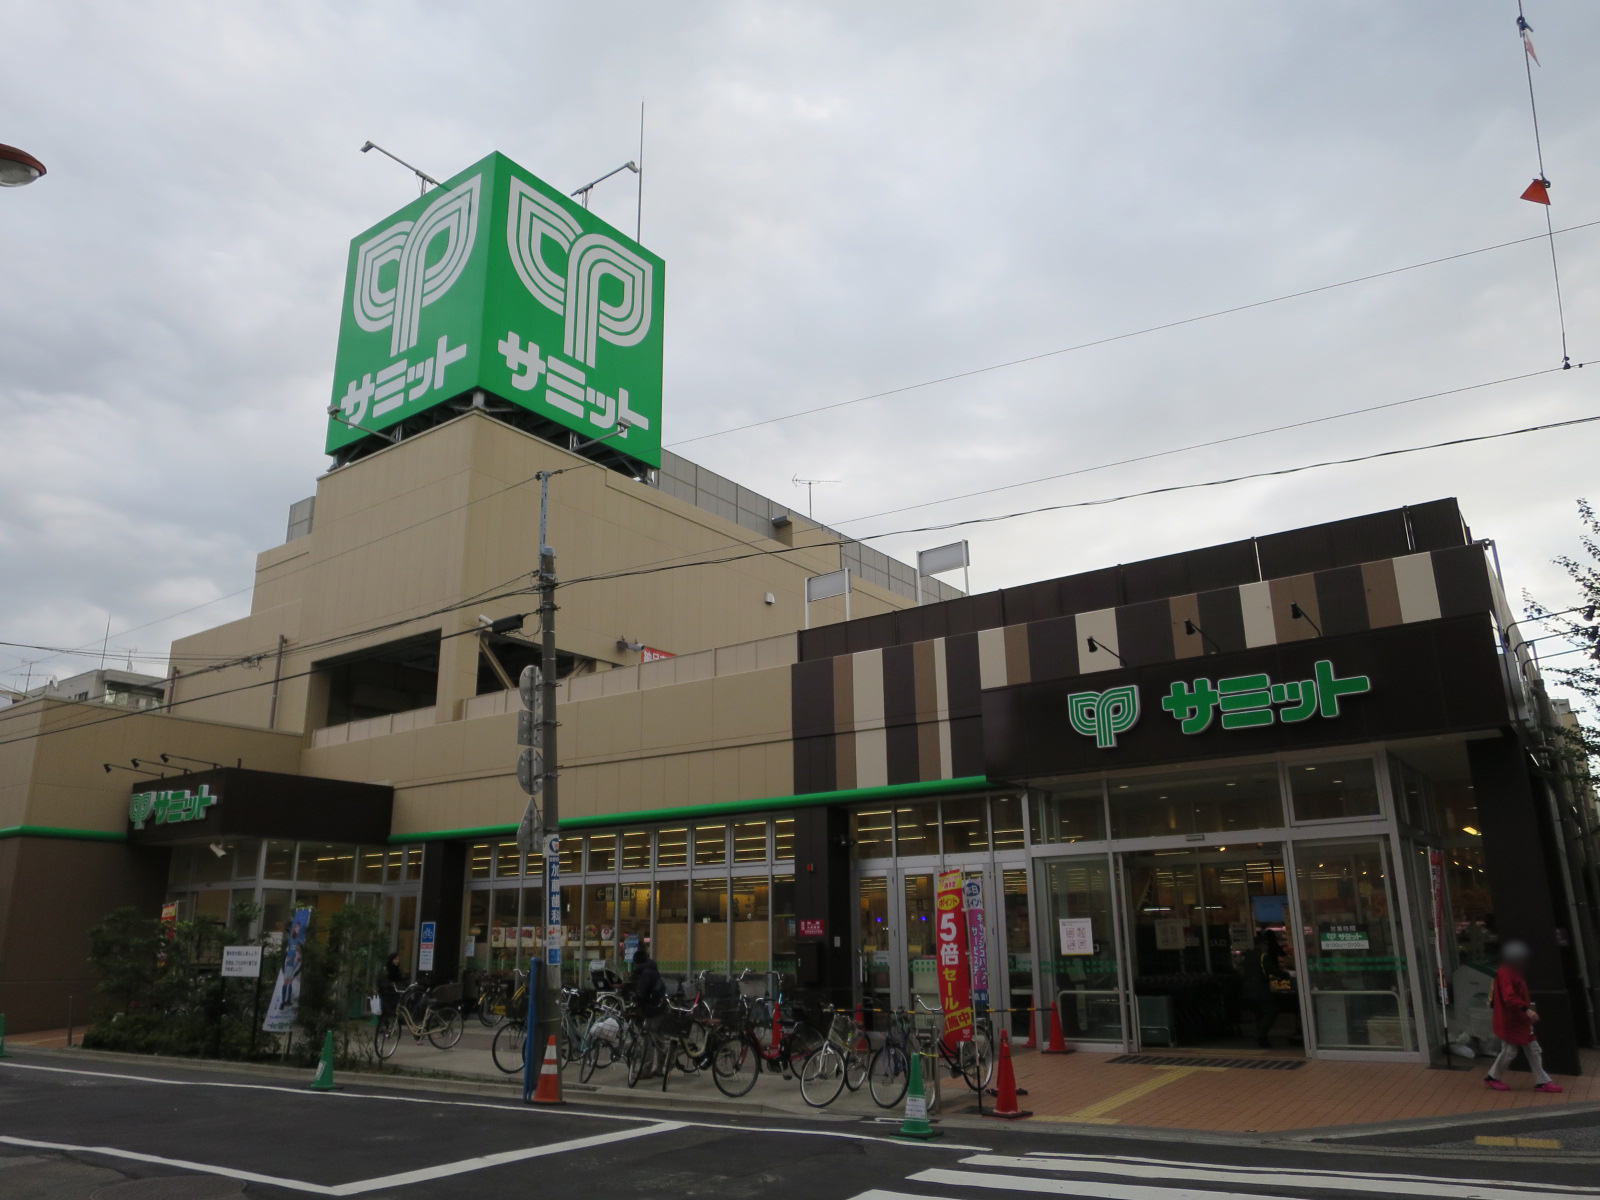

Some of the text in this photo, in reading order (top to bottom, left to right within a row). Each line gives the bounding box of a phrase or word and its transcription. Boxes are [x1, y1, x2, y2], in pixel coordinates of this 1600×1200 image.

[340, 334, 467, 429] サミット
[497, 330, 649, 439] サミット
[1161, 659, 1371, 735] サミット
[153, 784, 217, 825] サミット
[938, 897, 959, 908] ポイント
